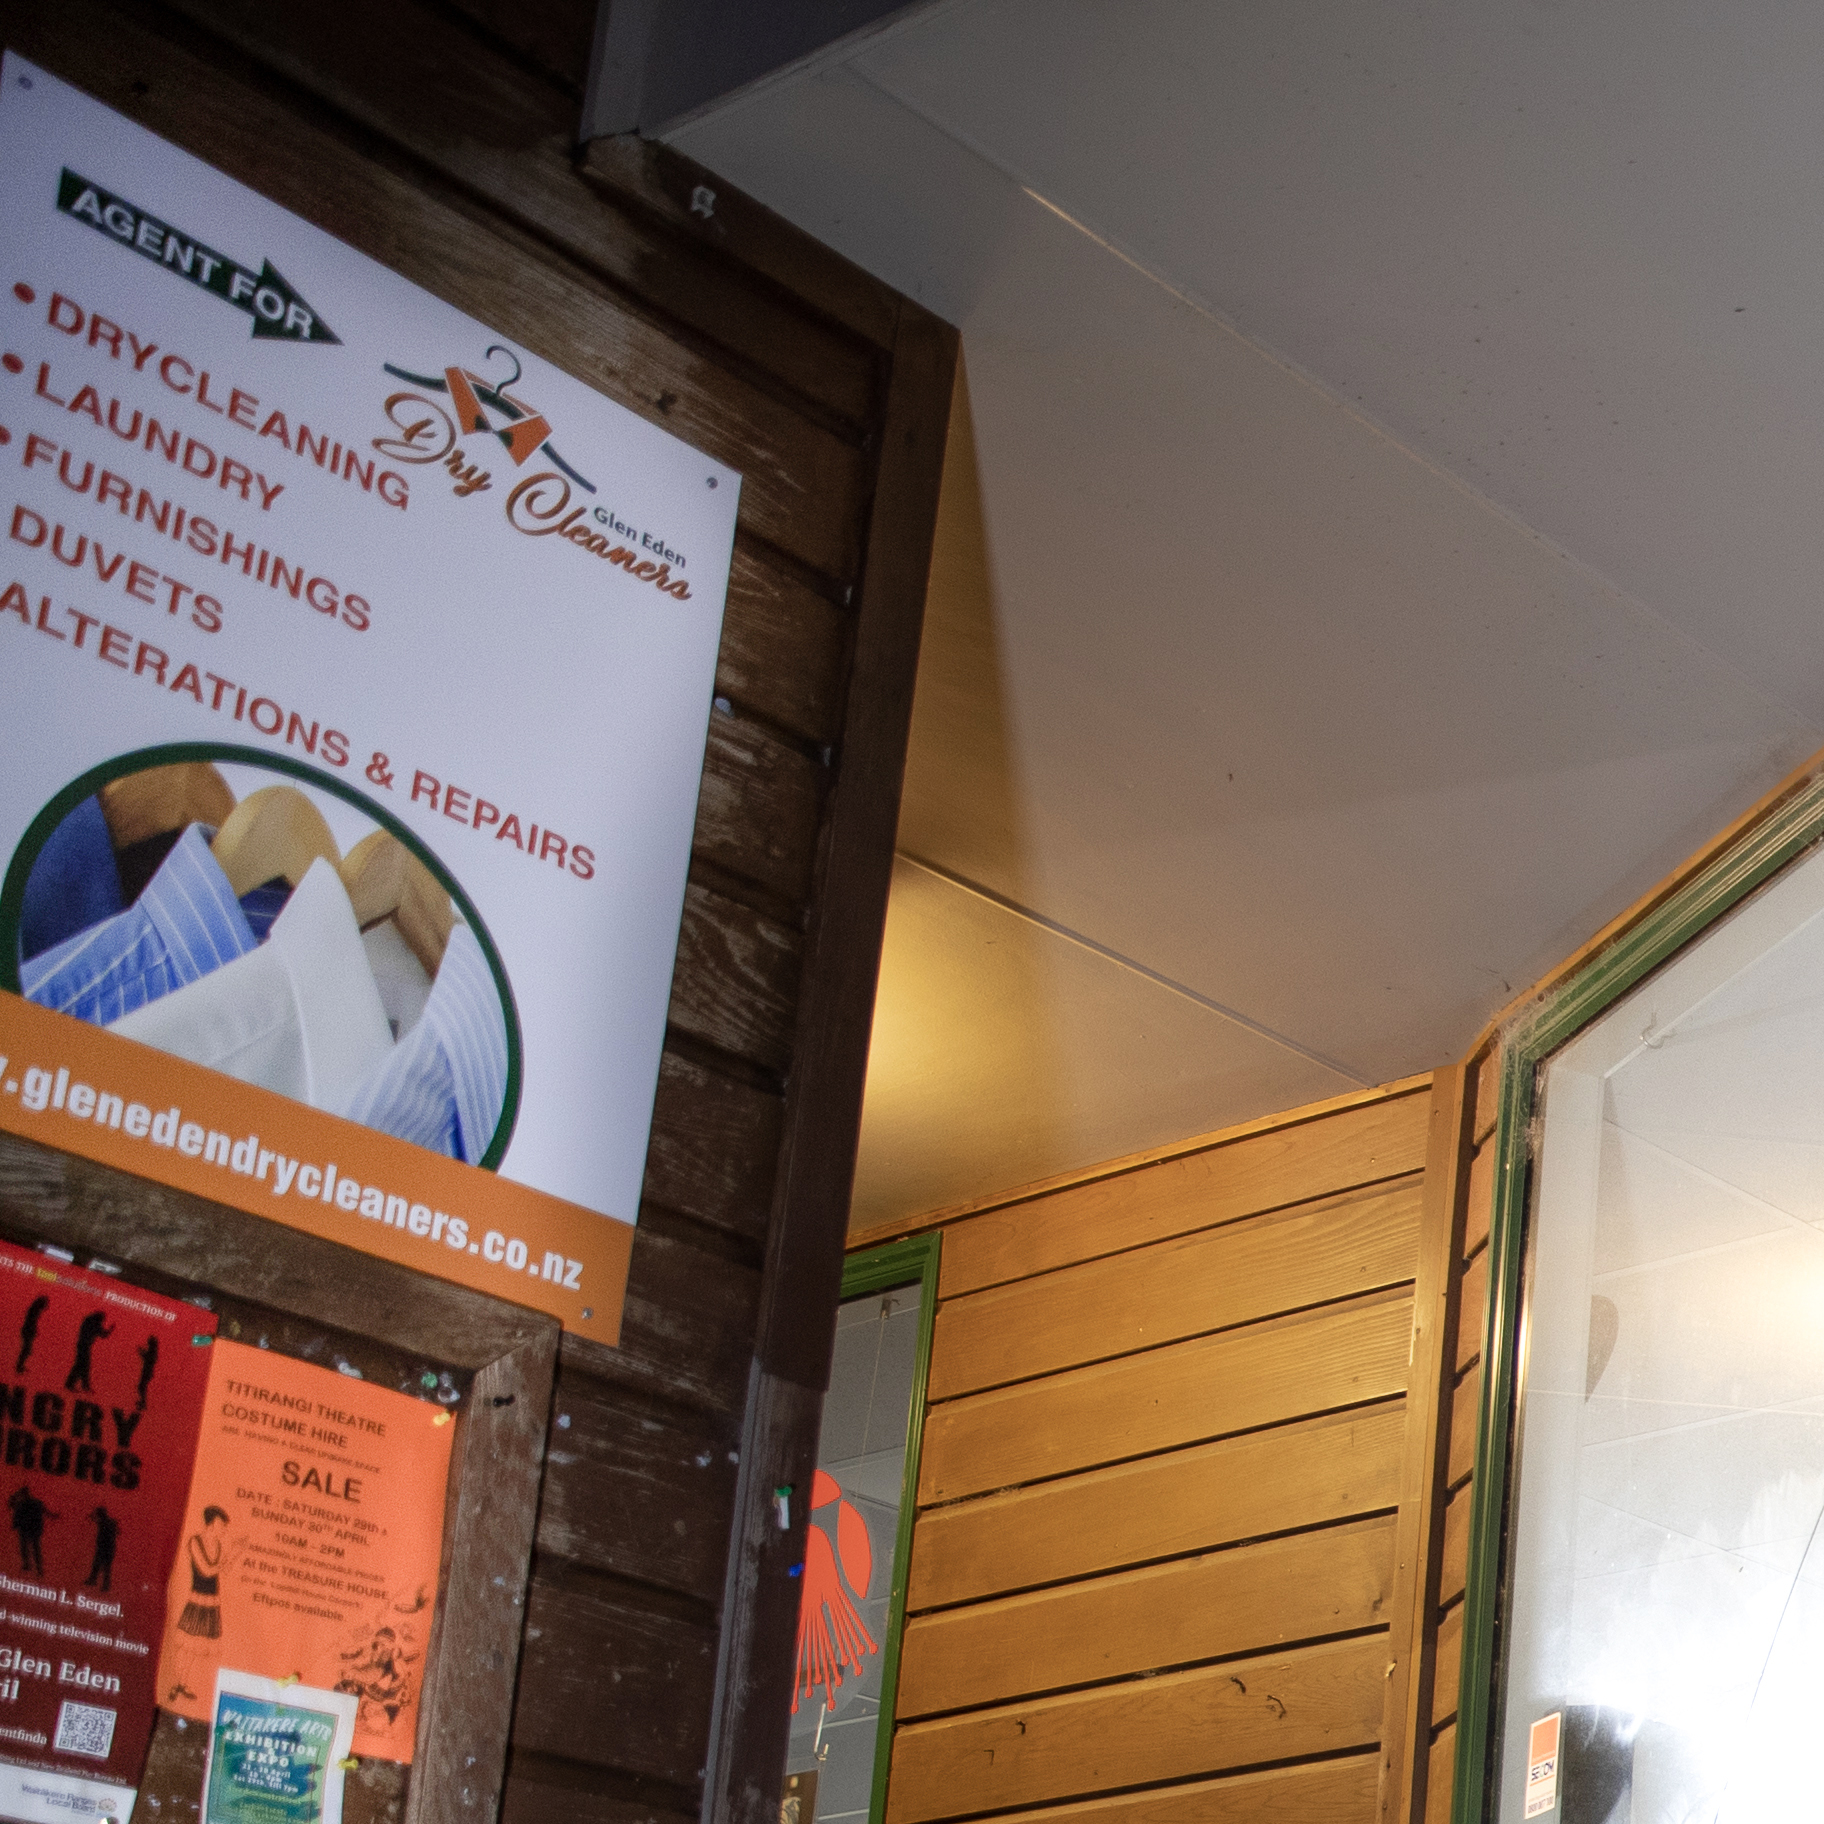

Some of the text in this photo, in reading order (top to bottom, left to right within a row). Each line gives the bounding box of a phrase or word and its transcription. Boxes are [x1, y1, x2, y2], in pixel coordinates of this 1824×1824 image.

[72, 185, 314, 340] AGENT FOR
[47, 292, 409, 510] DRYCLEANING
[35, 361, 284, 512] LAUNDRY
[372, 393, 694, 602] Dry Cleaners
[22, 433, 371, 633] FURNISHINGS
[594, 505, 688, 569] Glen Eden
[10, 505, 225, 634] DUVETS
[0, 582, 597, 882] ALTERATIONS & REPAIRS
[105, 1291, 164, 1319] PRODUCTION
[221, 1402, 349, 1449] COSTUME HIRE
[226, 1379, 387, 1437] TITIRANGI THEATRE
[0, 1426, 142, 1490] RORS
[281, 1460, 363, 1505] SALE
[235, 1487, 272, 1505] DATE
[282, 1499, 350, 1526] SATURDAY
[251, 1506, 305, 1529] SUNDAY
[334, 1528, 370, 1548] APRIL
[274, 1531, 346, 1560] 10AM 2PM
[60, 1589, 74, 1605] L.
[77, 1593, 124, 1618] Sergel.
[252, 1591, 291, 1610] Eftpos
[281, 1566, 345, 1591] TREASURE
[346, 1581, 388, 1601] HOUSE
[60, 1623, 113, 1646] television
[115, 1638, 150, 1655] movie
[59, 1661, 121, 1693] Eden
[223, 1730, 318, 1758] EXHIBITION
[246, 1750, 290, 1768] EXPO
